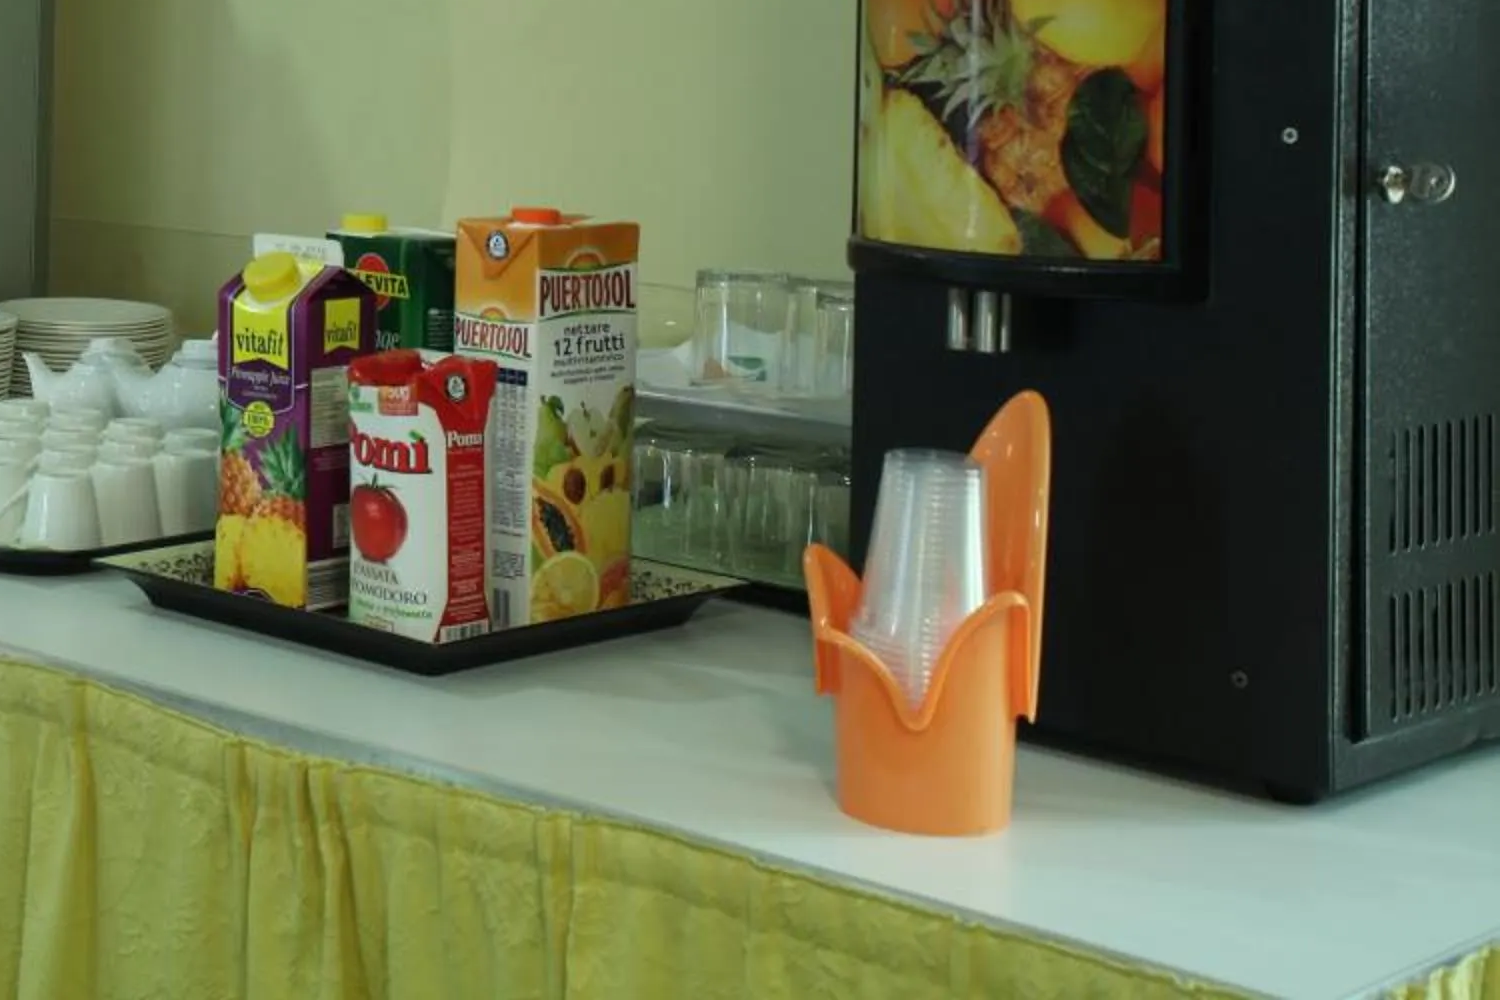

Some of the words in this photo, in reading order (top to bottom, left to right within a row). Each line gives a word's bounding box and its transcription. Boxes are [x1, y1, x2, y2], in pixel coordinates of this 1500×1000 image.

[539, 269, 636, 317] PUERTOSOL
[236, 327, 284, 357] vitafit
[326, 321, 358, 343] vitafit
[455, 316, 532, 358] PUERTOSOL
[563, 323, 611, 335] nettare
[554, 337, 573, 357] 12
[576, 333, 625, 355] frutti
